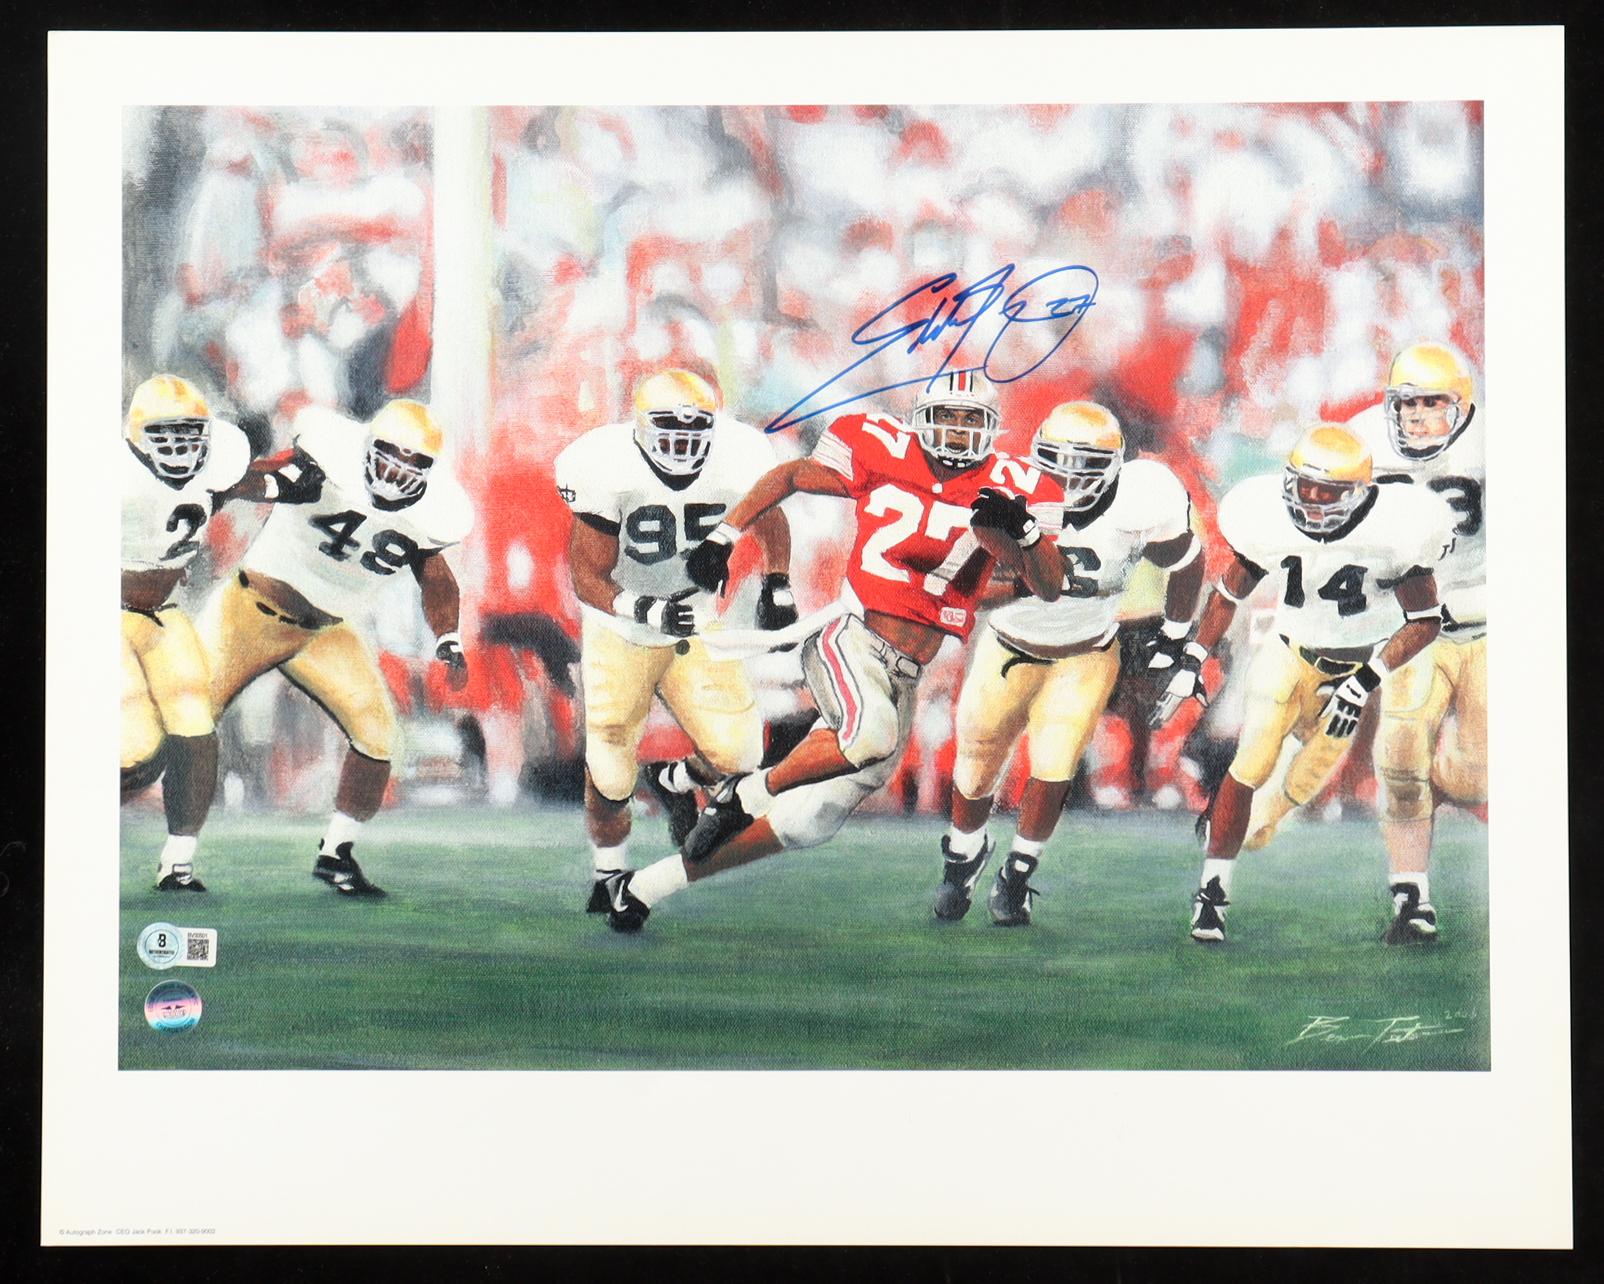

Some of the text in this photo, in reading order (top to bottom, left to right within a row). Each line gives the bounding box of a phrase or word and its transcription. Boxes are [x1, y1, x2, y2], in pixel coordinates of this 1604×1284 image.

[159, 503, 207, 561] 2
[624, 503, 727, 566] 95
[860, 483, 984, 596] 27
[1280, 555, 1368, 618] 14
[66, 1229, 96, 1237] Autograph
